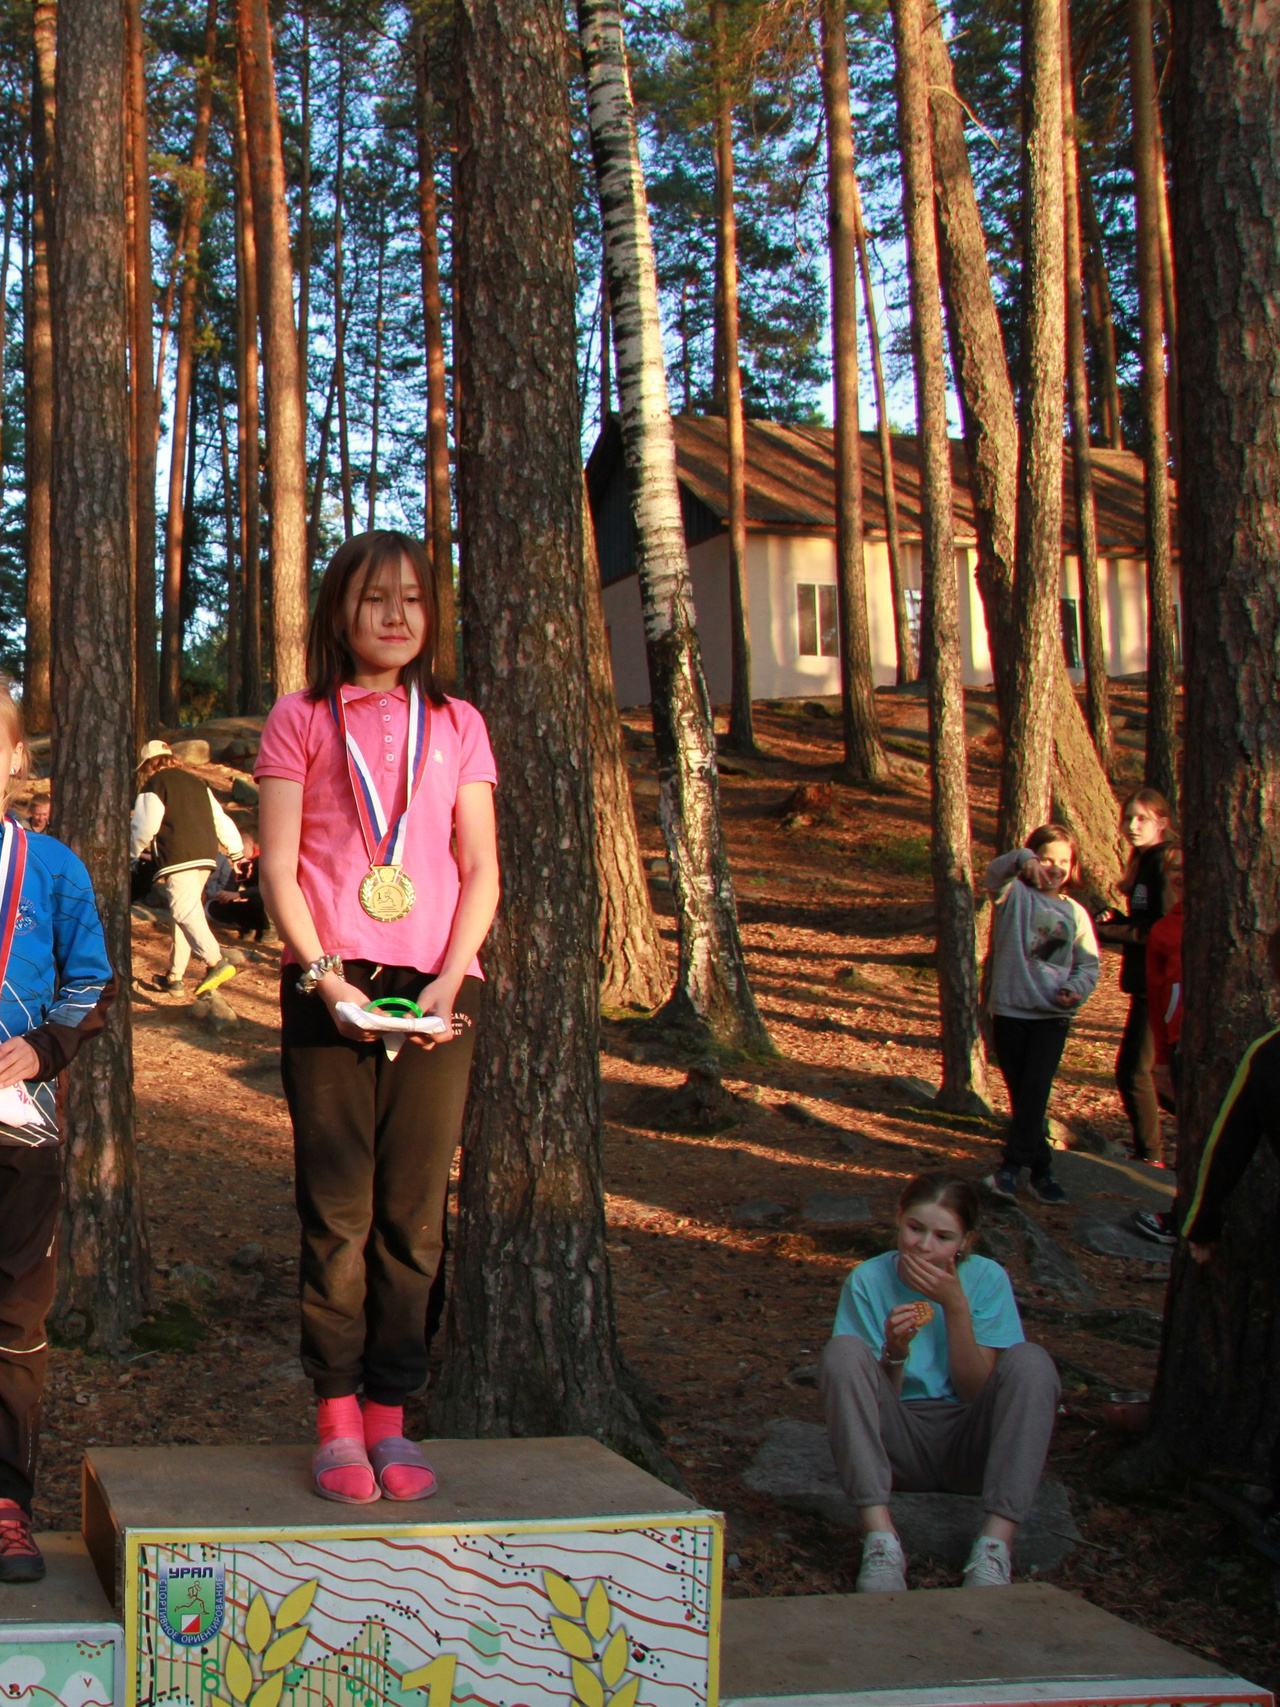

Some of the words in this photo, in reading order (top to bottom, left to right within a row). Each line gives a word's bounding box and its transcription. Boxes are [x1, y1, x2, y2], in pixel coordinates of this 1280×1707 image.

[169, 1567, 213, 1578] УРАЛ
[159, 1579, 178, 1639] СПОРТИВНОЕ
[181, 1577, 223, 1643] ОРИЕНТИРОВАНИЕ
[401, 1654, 457, 1707] 1
